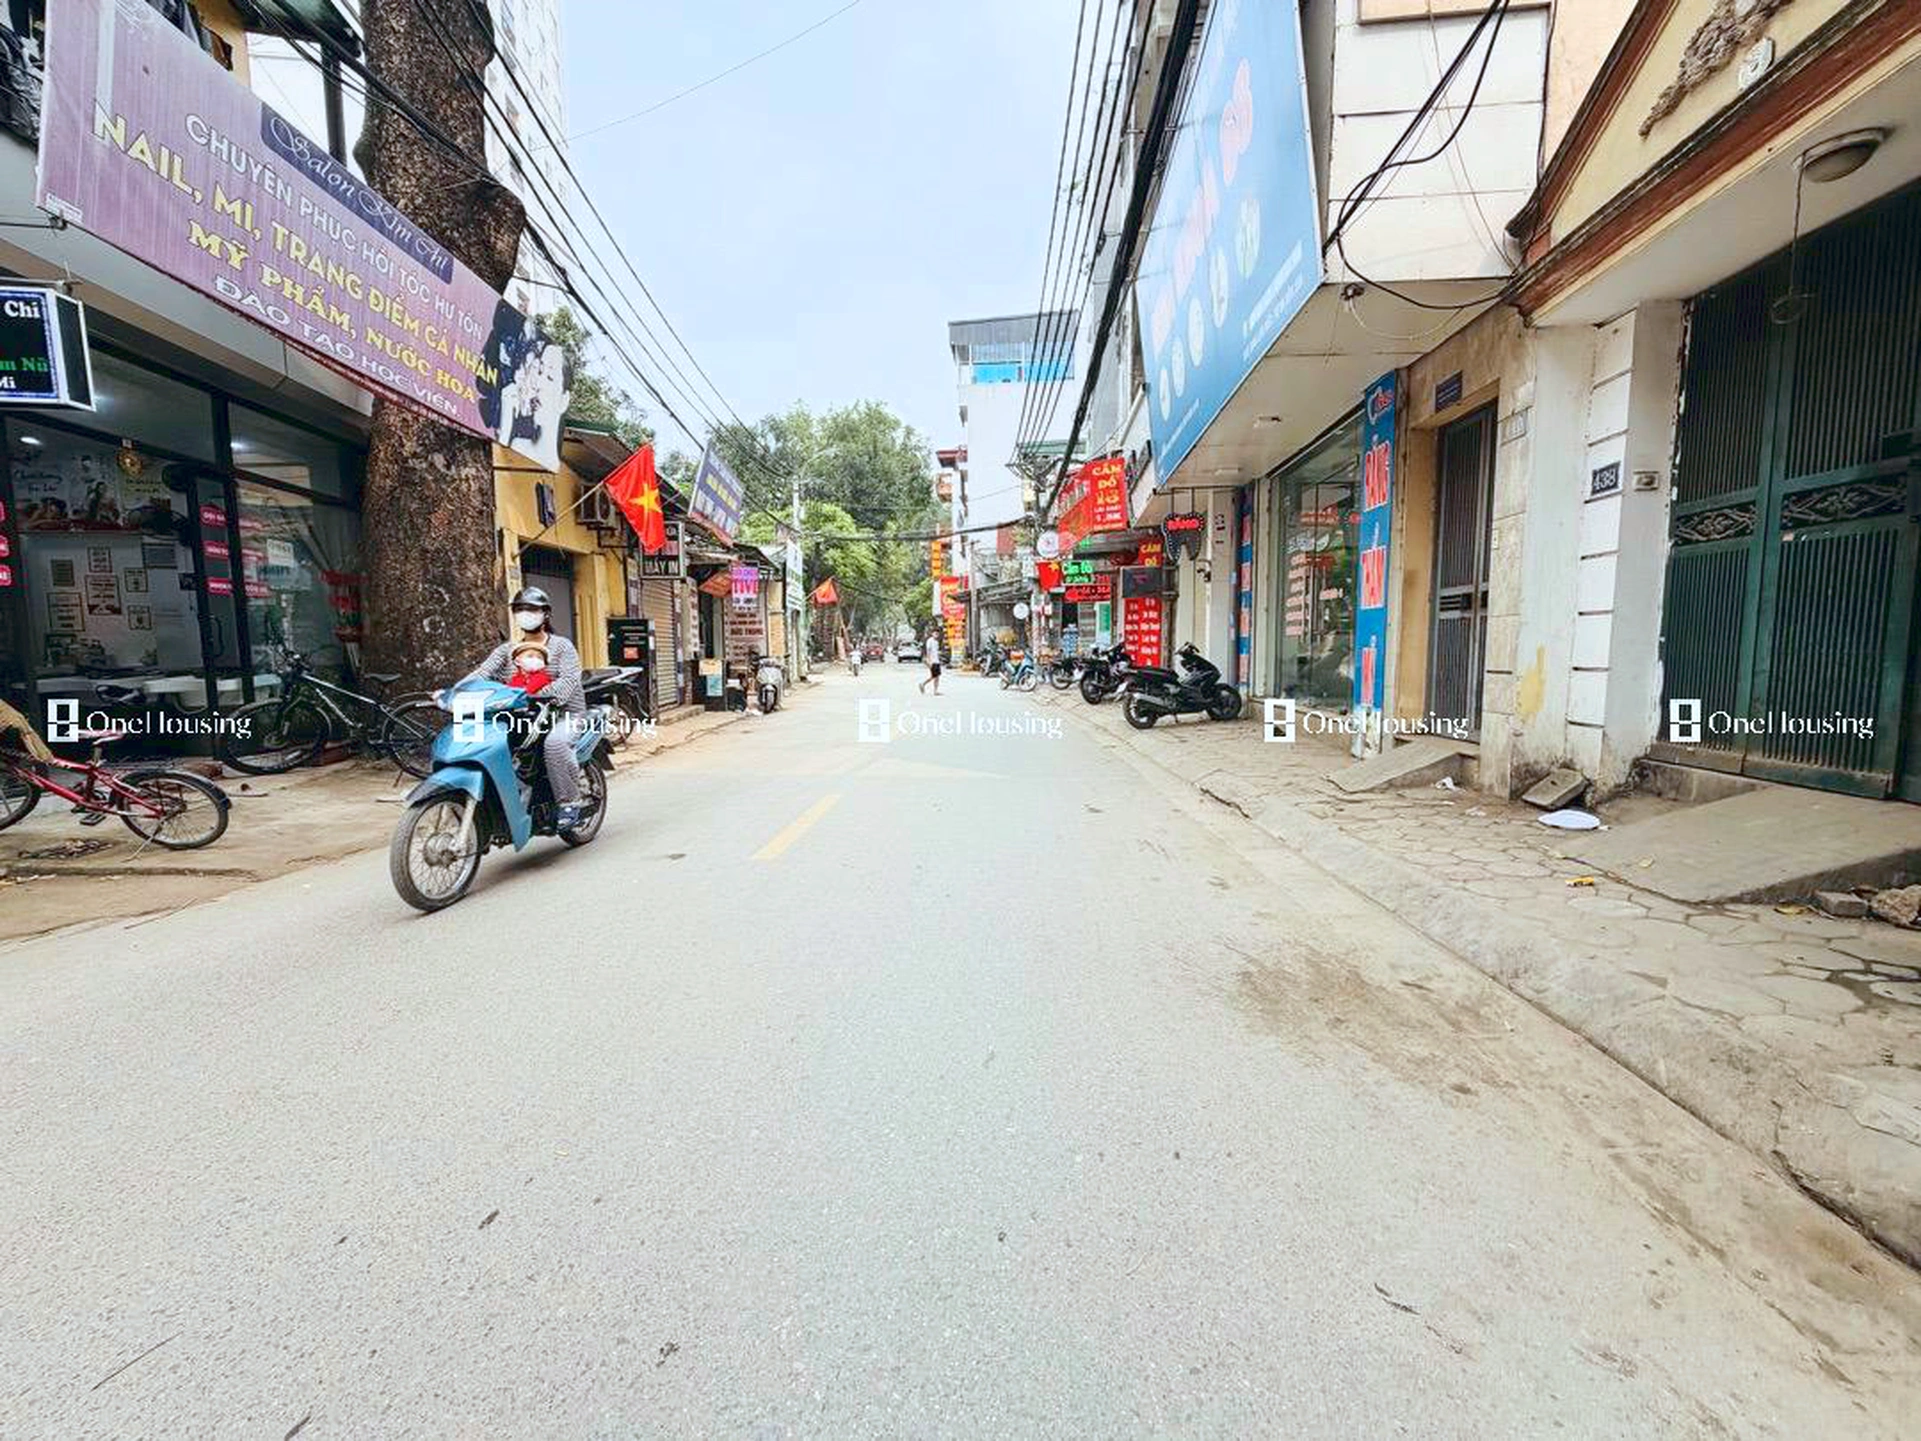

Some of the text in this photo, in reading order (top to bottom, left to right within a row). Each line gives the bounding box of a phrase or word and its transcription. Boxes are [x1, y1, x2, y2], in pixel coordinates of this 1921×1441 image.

[91, 100, 203, 204] NAIL,
[271, 220, 363, 300] TRANG
[185, 113, 292, 206] CHUYÊN
[270, 116, 355, 196] Salon
[188, 219, 476, 404] MỸ PHẨM, NƯỚC HOA
[214, 275, 291, 326] ĐÀO
